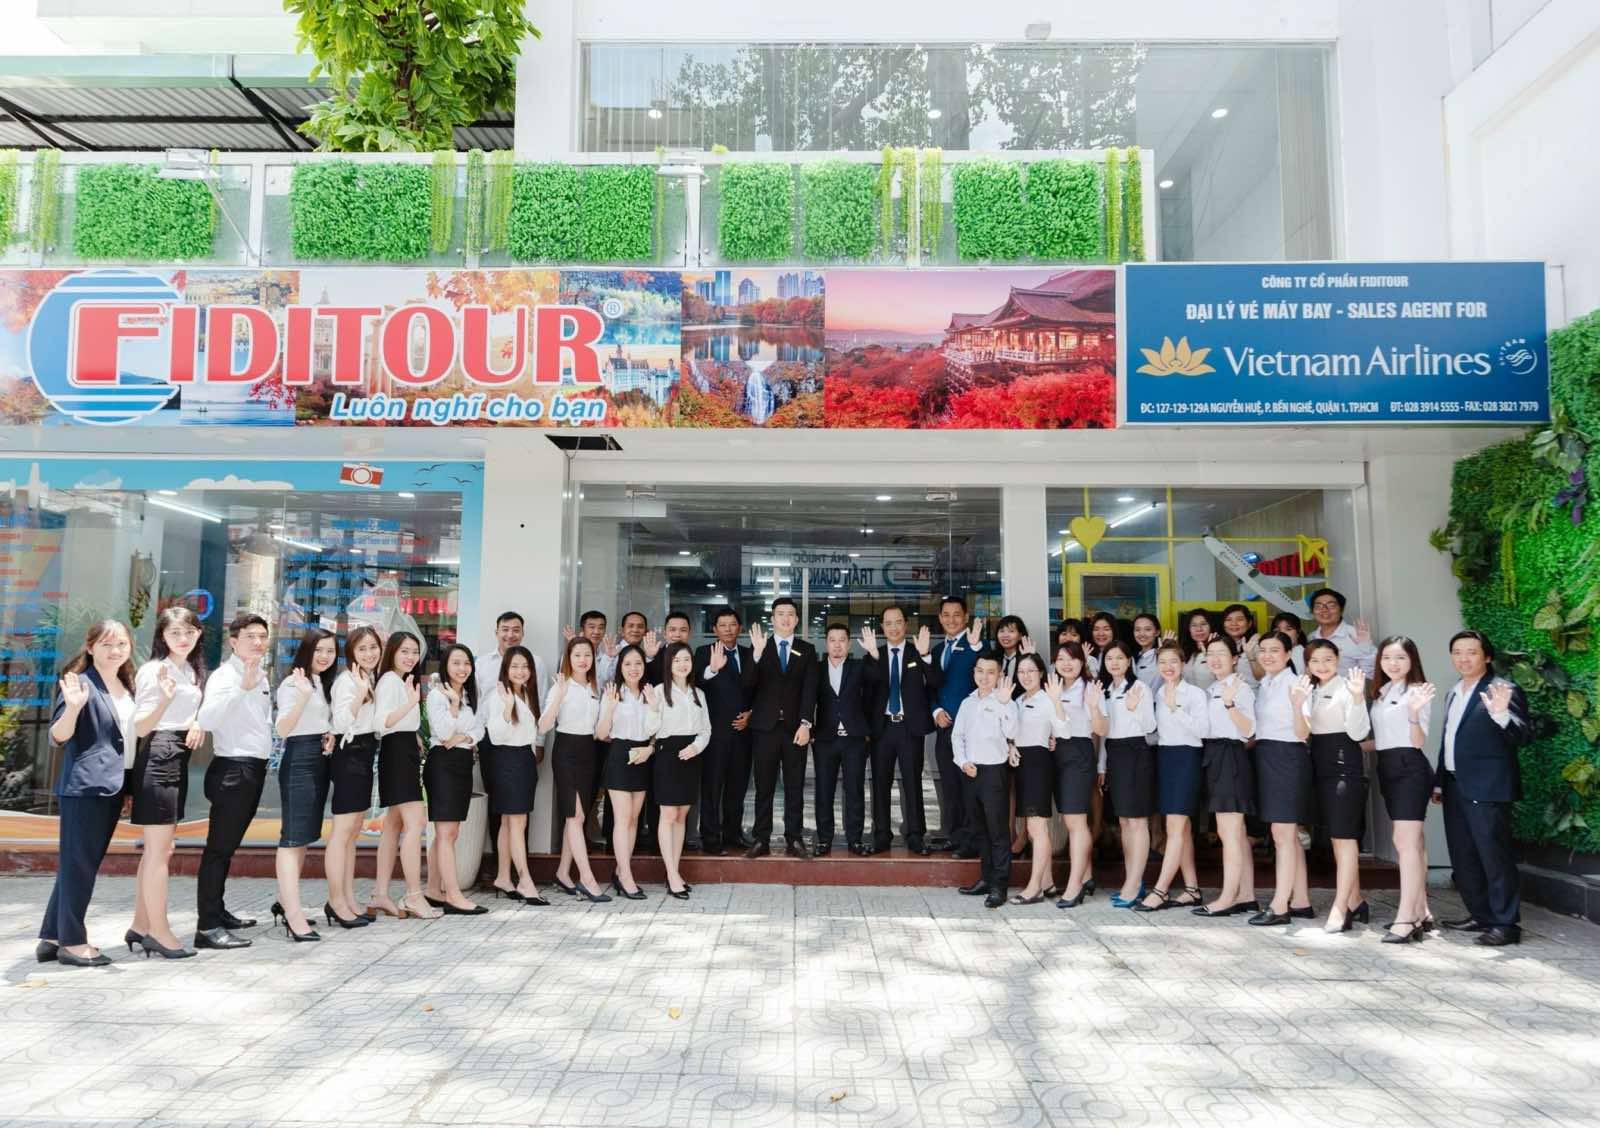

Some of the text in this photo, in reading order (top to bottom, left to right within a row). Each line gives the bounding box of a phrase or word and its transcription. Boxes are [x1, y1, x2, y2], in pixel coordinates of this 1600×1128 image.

[1261, 275, 1292, 288] CÔNG
[1294, 276, 1307, 288] TY
[1360, 275, 1409, 288] FIDITOUR
[1186, 303, 1213, 323] ĐẠI
[1217, 300, 1235, 320] LÝ
[1239, 300, 1259, 320] VÉ
[1263, 300, 1298, 320] MÁY
[1302, 302, 1333, 319] BAY
[1347, 302, 1397, 319] SALES
[1400, 301, 1452, 319] AGENT
[1456, 301, 1488, 319] FOR
[70, 303, 602, 384] FIDITOUR
[1223, 343, 1491, 377] Vietnam Airlines
[331, 393, 606, 425] Luôn nghĩ cho bạn
[1155, 402, 1210, 414] 127-129-129A
[1315, 400, 1340, 415] QUẬN
[1349, 402, 1379, 414] TP.HCM
[1404, 401, 1419, 412] 028
[1420, 401, 1440, 412] 3914
[1440, 401, 1460, 412] 5555
[1464, 400, 1483, 412] FAX:
[1483, 401, 1498, 412] 028
[1499, 401, 1518, 412] 3821
[1519, 401, 1540, 412] 7979
